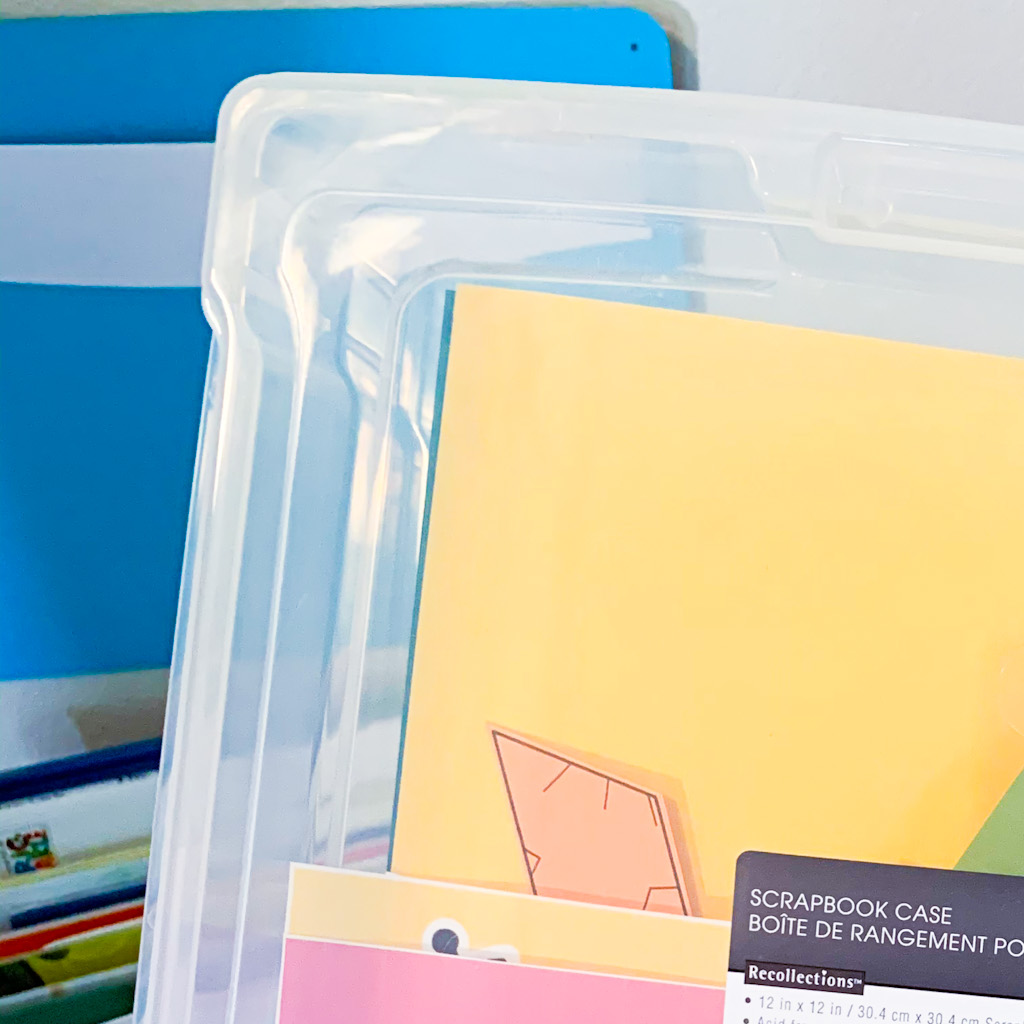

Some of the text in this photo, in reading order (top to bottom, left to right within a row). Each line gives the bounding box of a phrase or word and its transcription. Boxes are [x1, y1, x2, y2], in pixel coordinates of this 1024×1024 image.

[749, 888, 953, 925] SCRAPBOOK CASE
[748, 913, 808, 937] BOÎTE
[815, 919, 844, 941] DE
[850, 923, 988, 954] RANGEMENT
[760, 996, 774, 1009] 12
[780, 997, 791, 1011] in
[797, 1002, 804, 1012] x
[810, 1001, 825, 1014] 12
[831, 1002, 842, 1015] in
[847, 1004, 853, 1017] /
[858, 1005, 886, 1020] 30.4
[892, 1010, 910, 1022] cm
[915, 1013, 922, 1023] x
